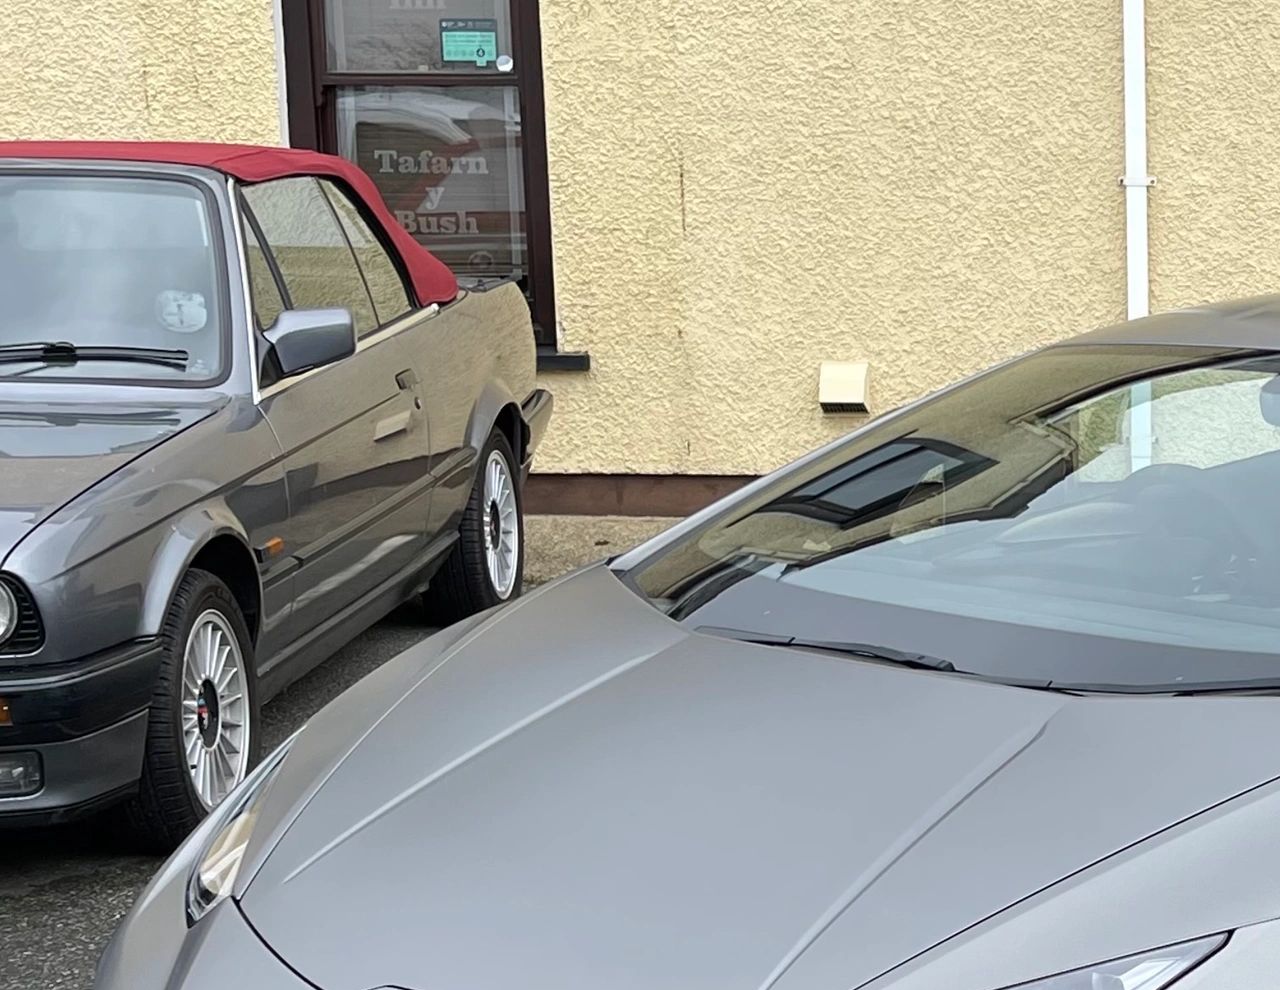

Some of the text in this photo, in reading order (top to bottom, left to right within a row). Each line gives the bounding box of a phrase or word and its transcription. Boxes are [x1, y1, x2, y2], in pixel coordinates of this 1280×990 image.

[374, 150, 489, 174] Tafarn
[425, 187, 445, 210] y
[395, 210, 479, 234] Bush
